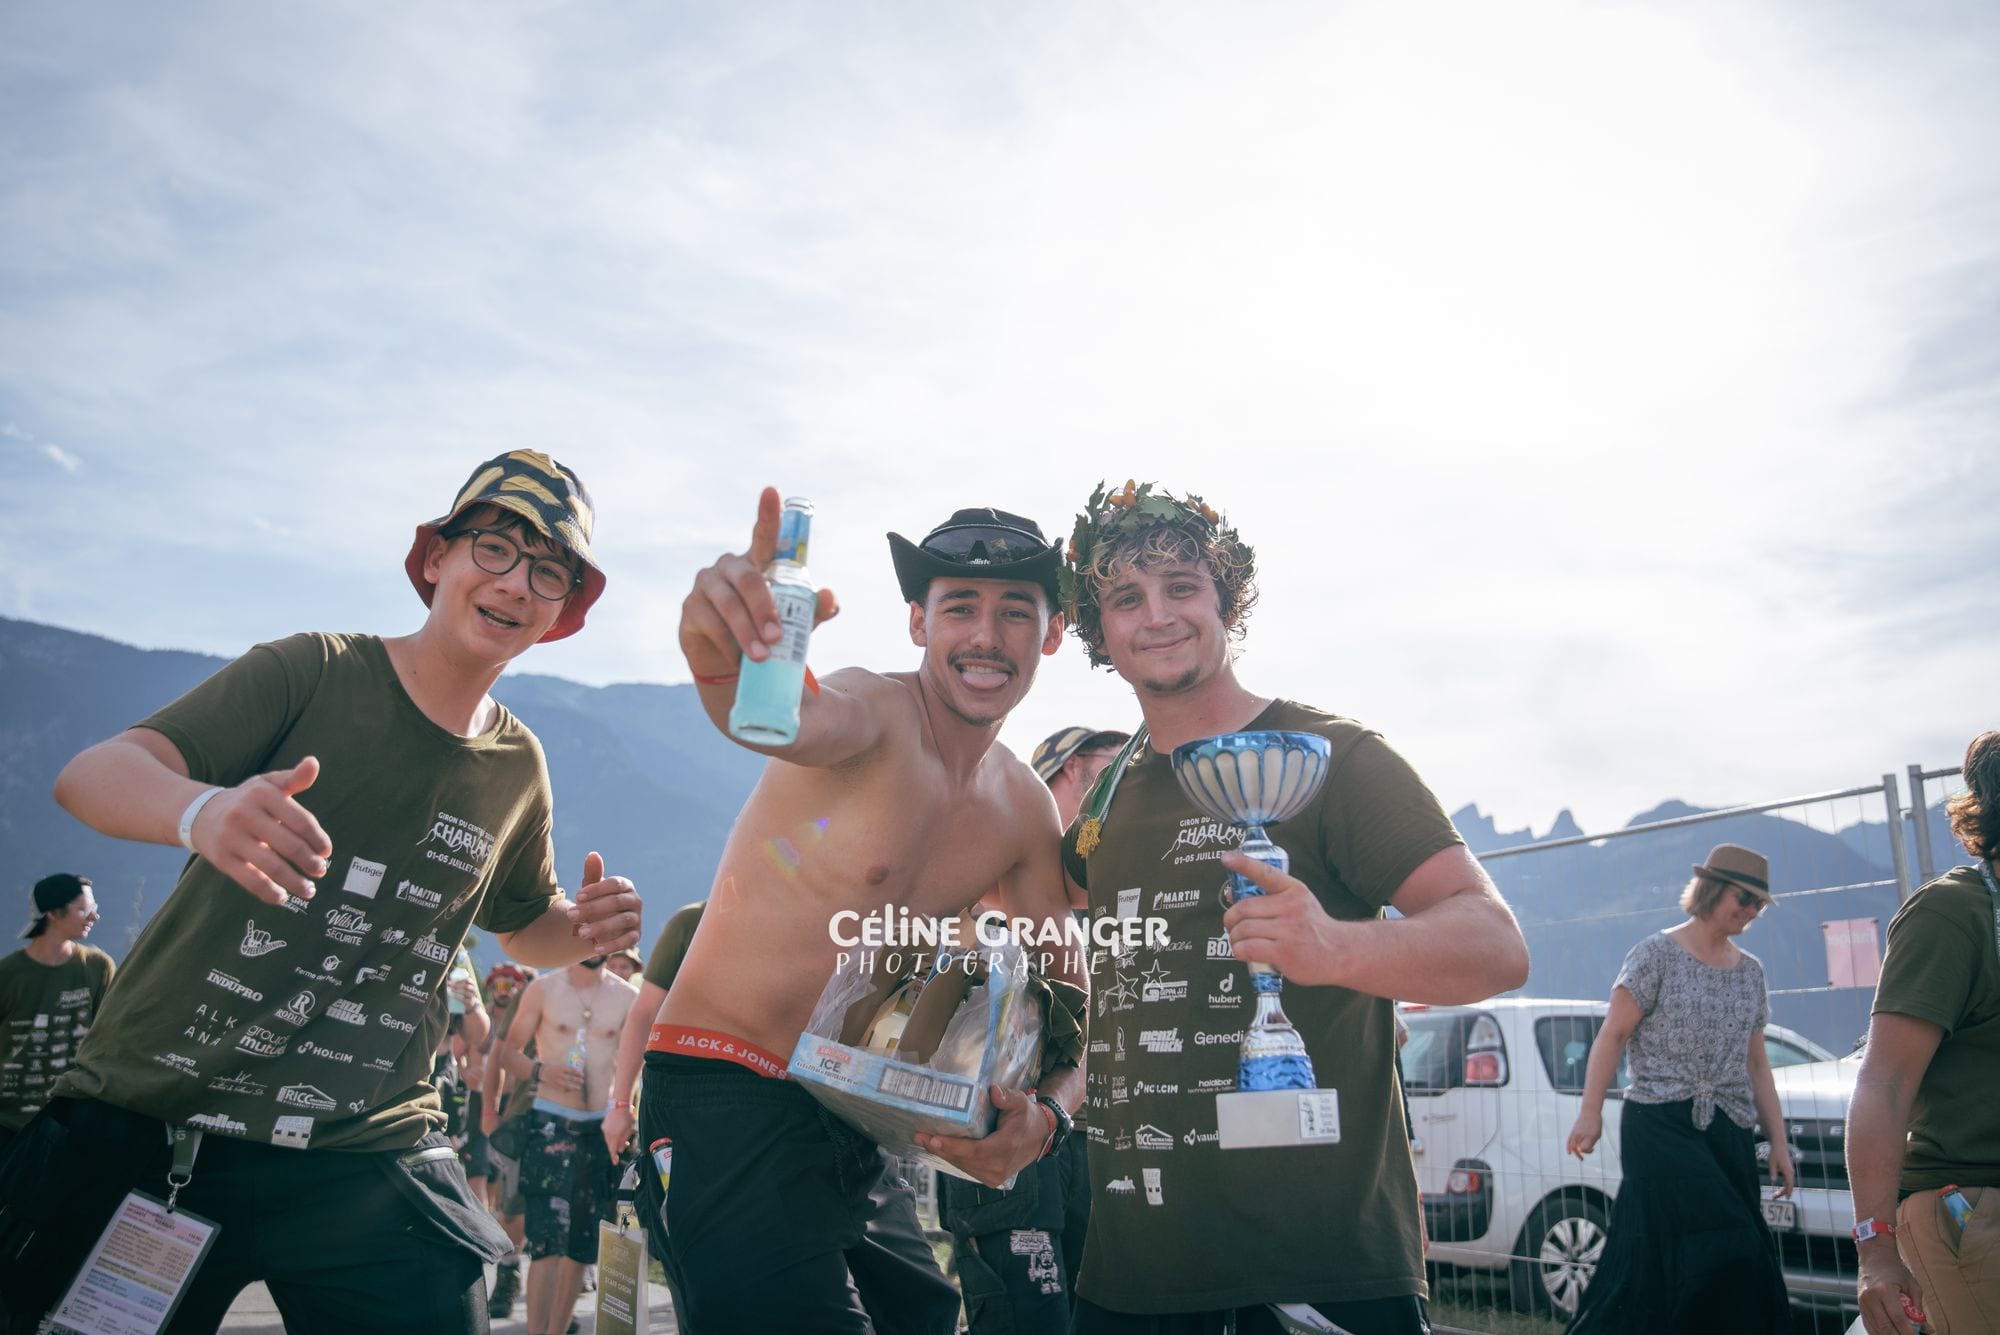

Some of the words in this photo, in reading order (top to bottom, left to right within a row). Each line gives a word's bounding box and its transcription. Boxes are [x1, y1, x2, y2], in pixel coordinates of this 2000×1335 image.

[438, 812, 459, 824] GIRON
[459, 817, 469, 828] DU
[1179, 818, 1200, 828] GIRON
[1201, 816, 1211, 825] DU
[426, 850, 450, 865] 01-05
[449, 857, 474, 874] JUILLET
[1174, 852, 1195, 865] 01-05
[351, 861, 384, 878] Frutiger
[1162, 890, 1200, 903] MARTIN
[413, 936, 450, 963] BOXER
[1206, 940, 1235, 958] BOX
[206, 971, 264, 1002] INDUPRO
[400, 982, 430, 1000] hubert
[331, 999, 364, 1014] enzi
[1208, 991, 1243, 1004] hubert
[274, 1008, 311, 1028] RODUIT
[379, 1012, 417, 1034] Gene
[247, 1024, 290, 1046] group
[1194, 1030, 1245, 1046] Genedi
[239, 1034, 289, 1056] mutue
[312, 1046, 354, 1064] HOLCIM
[676, 1033, 722, 1052] JACK
[722, 1042, 735, 1055] &
[737, 1047, 788, 1080] JONES
[819, 1057, 842, 1074] ICE
[1196, 1130, 1220, 1142] vaud
[1767, 1204, 1792, 1223] 574
